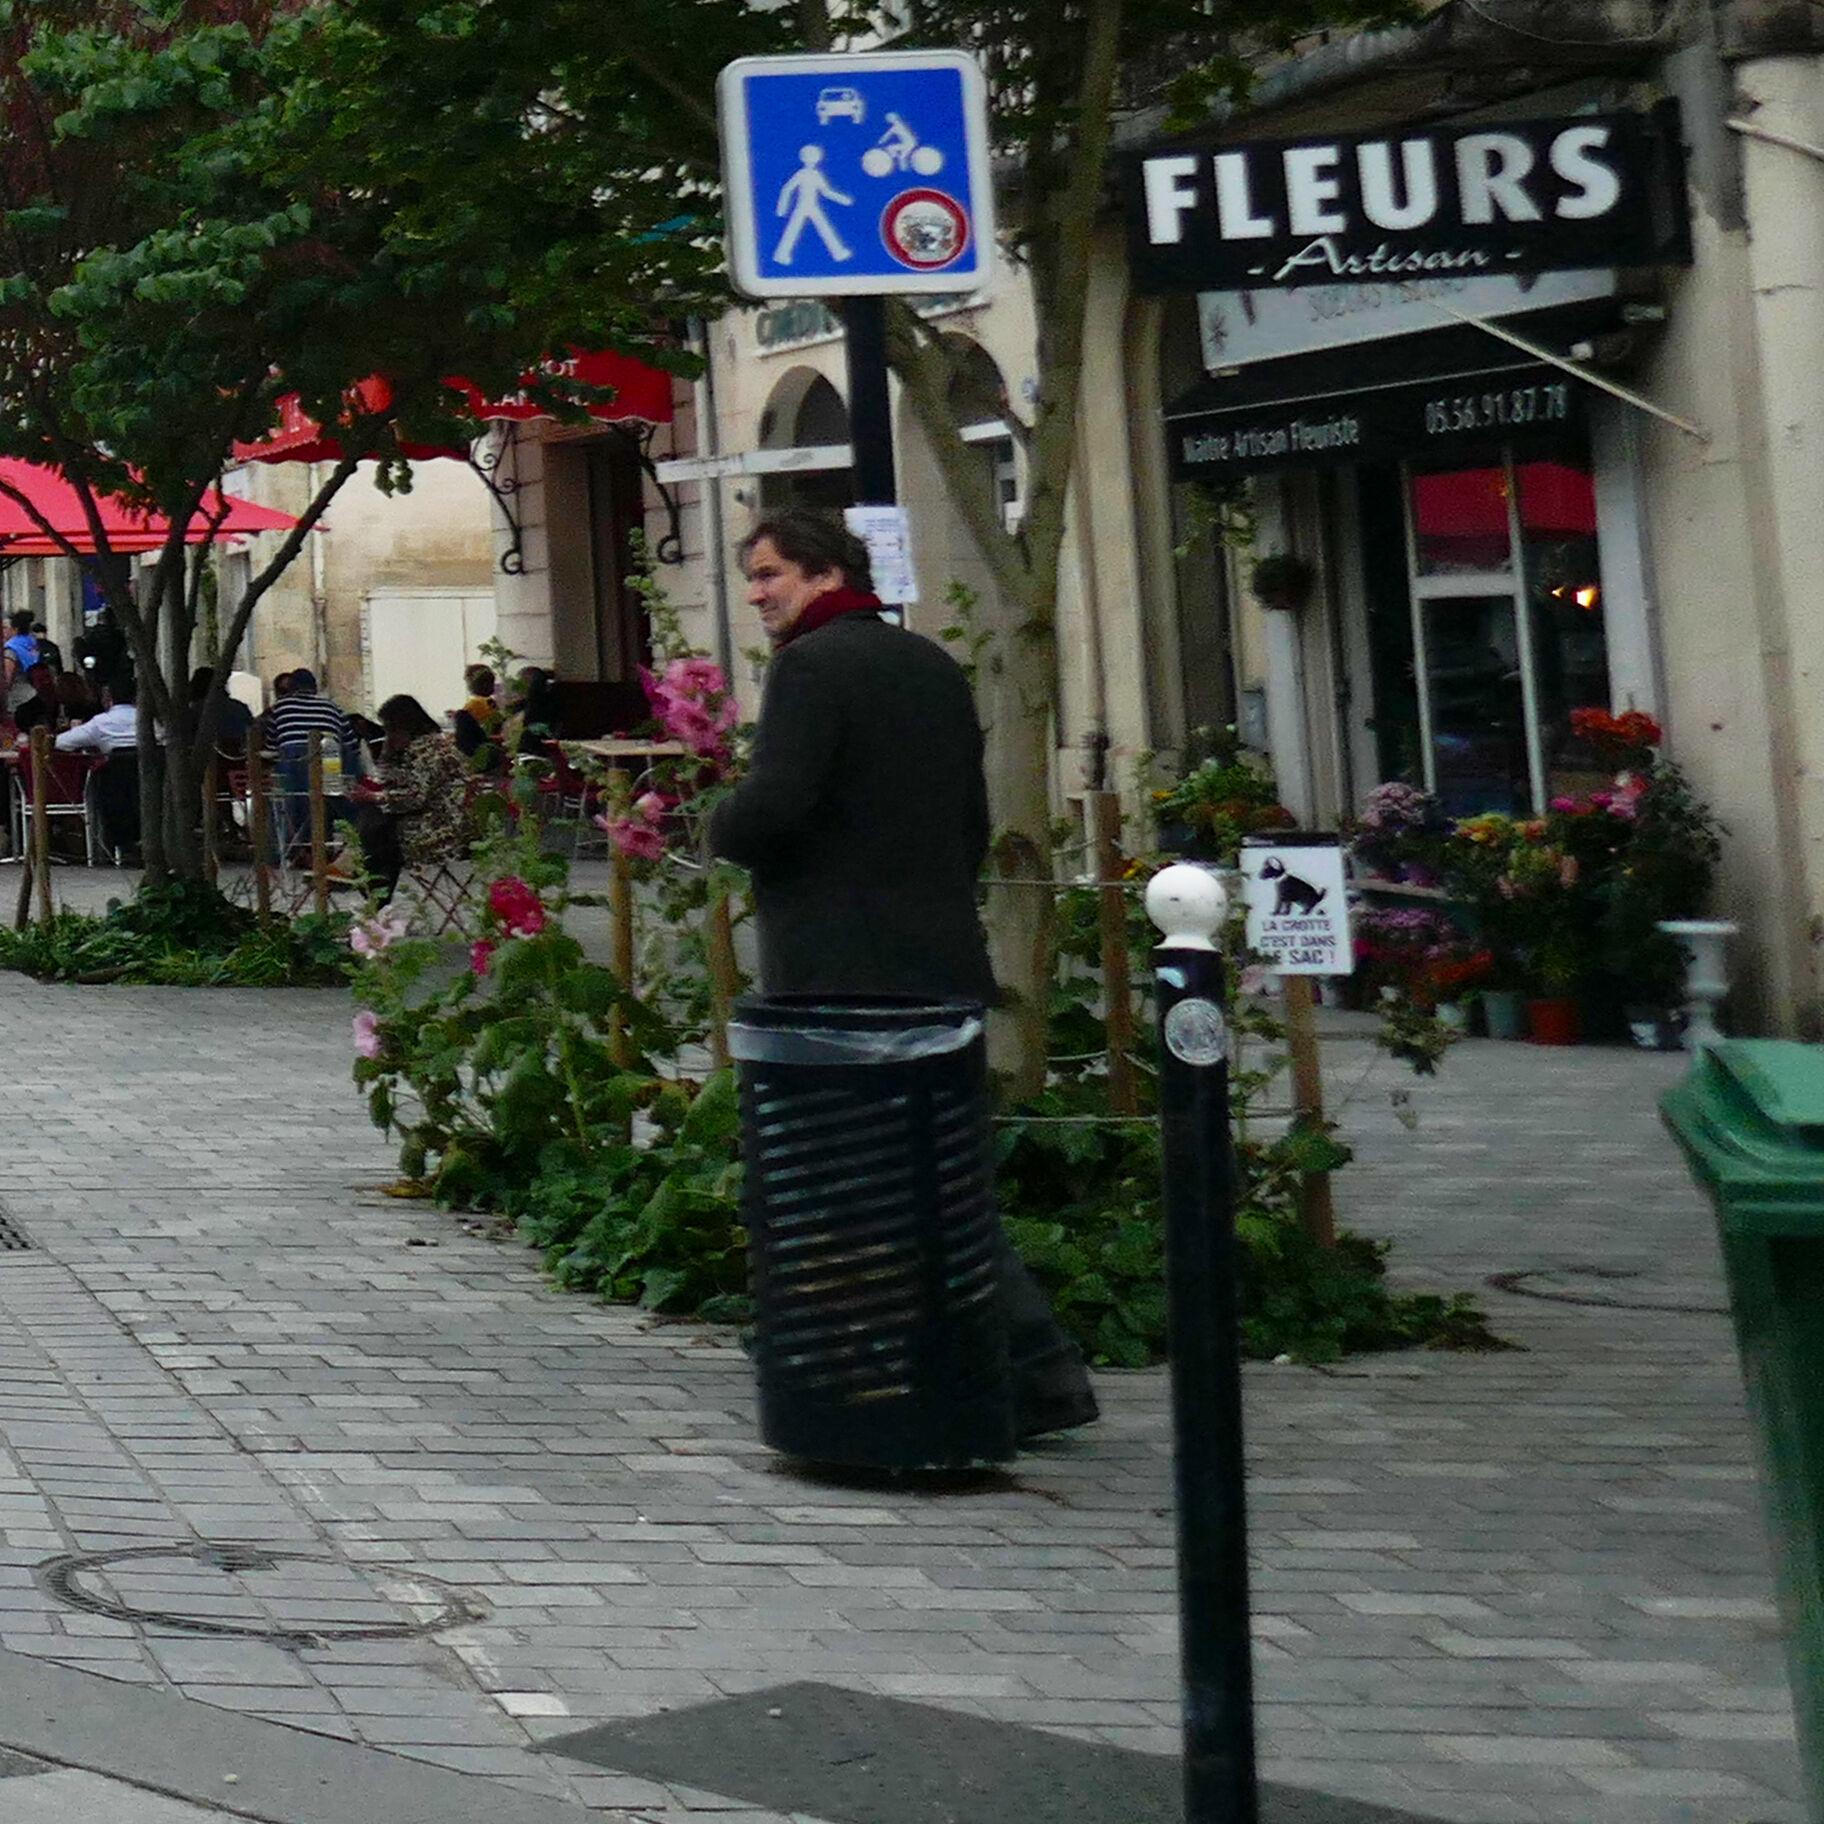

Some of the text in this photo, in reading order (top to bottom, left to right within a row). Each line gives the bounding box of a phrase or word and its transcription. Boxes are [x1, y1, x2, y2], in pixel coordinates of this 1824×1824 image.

[1143, 125, 1620, 245] FLEURS
[1272, 236, 1490, 281] Artisan
[1262, 919, 1330, 931] LA CROTTE
[1301, 936, 1336, 947] DANS
[1289, 949, 1324, 965] SAC
